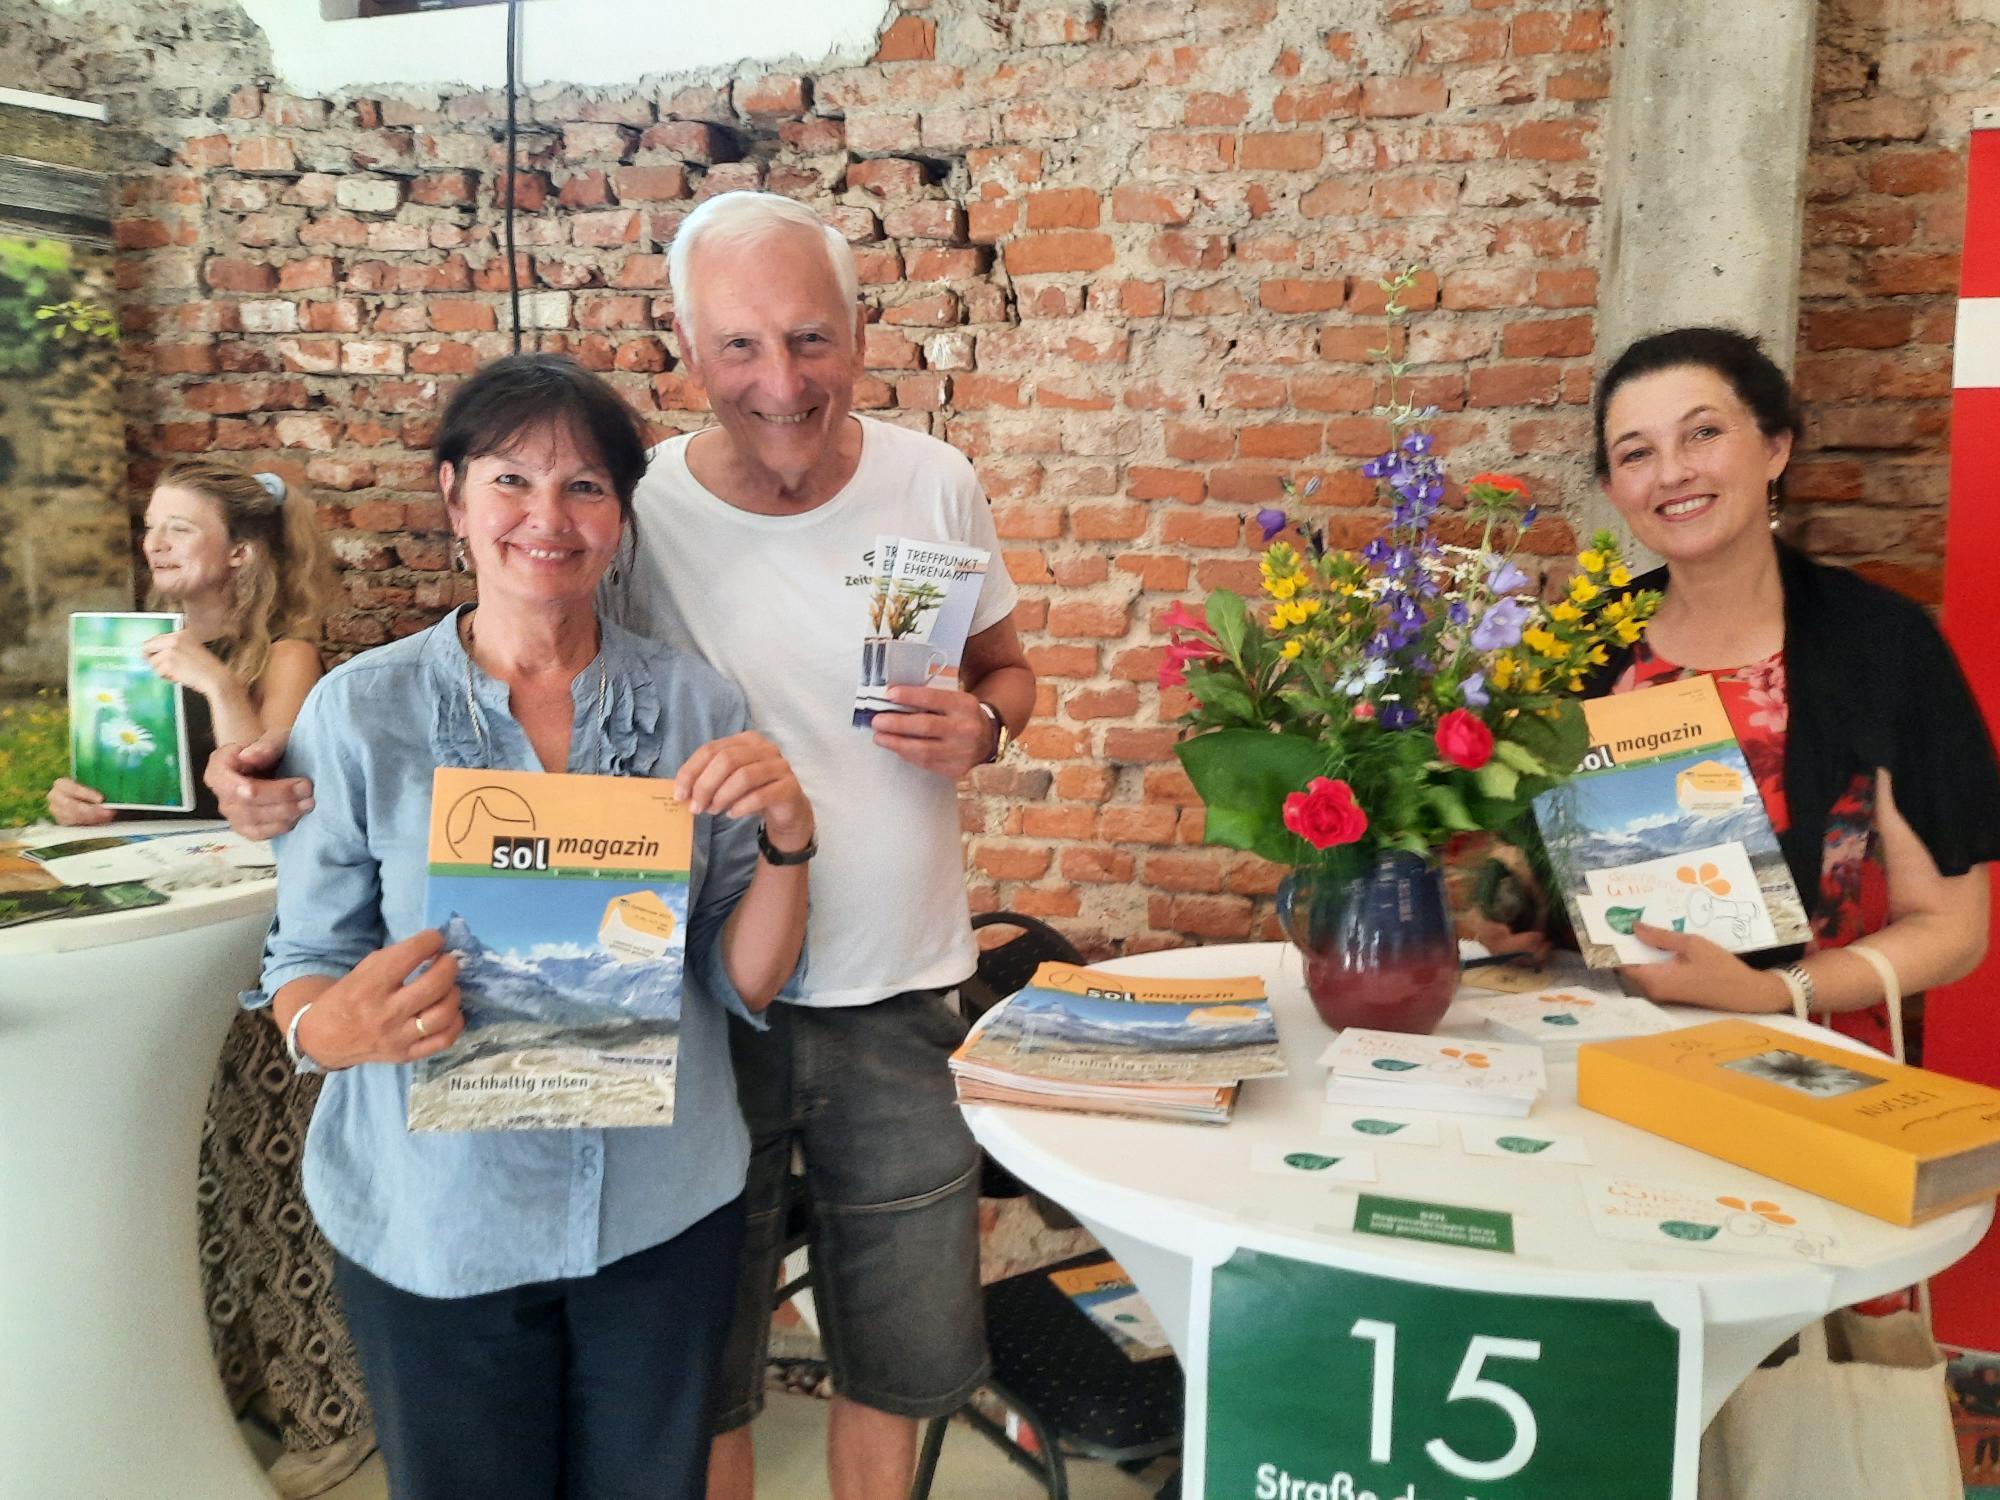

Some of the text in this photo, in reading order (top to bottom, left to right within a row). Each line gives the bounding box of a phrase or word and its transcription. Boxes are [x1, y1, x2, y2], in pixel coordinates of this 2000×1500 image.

[907, 549, 978, 569] TREFFPUNKT
[903, 562, 969, 581] EHRENAMT
[1616, 723, 1702, 751] magazin
[493, 835, 660, 870] sol magazin
[451, 1074, 536, 1092] Nachhaltig
[1351, 1318, 1541, 1481] 15
